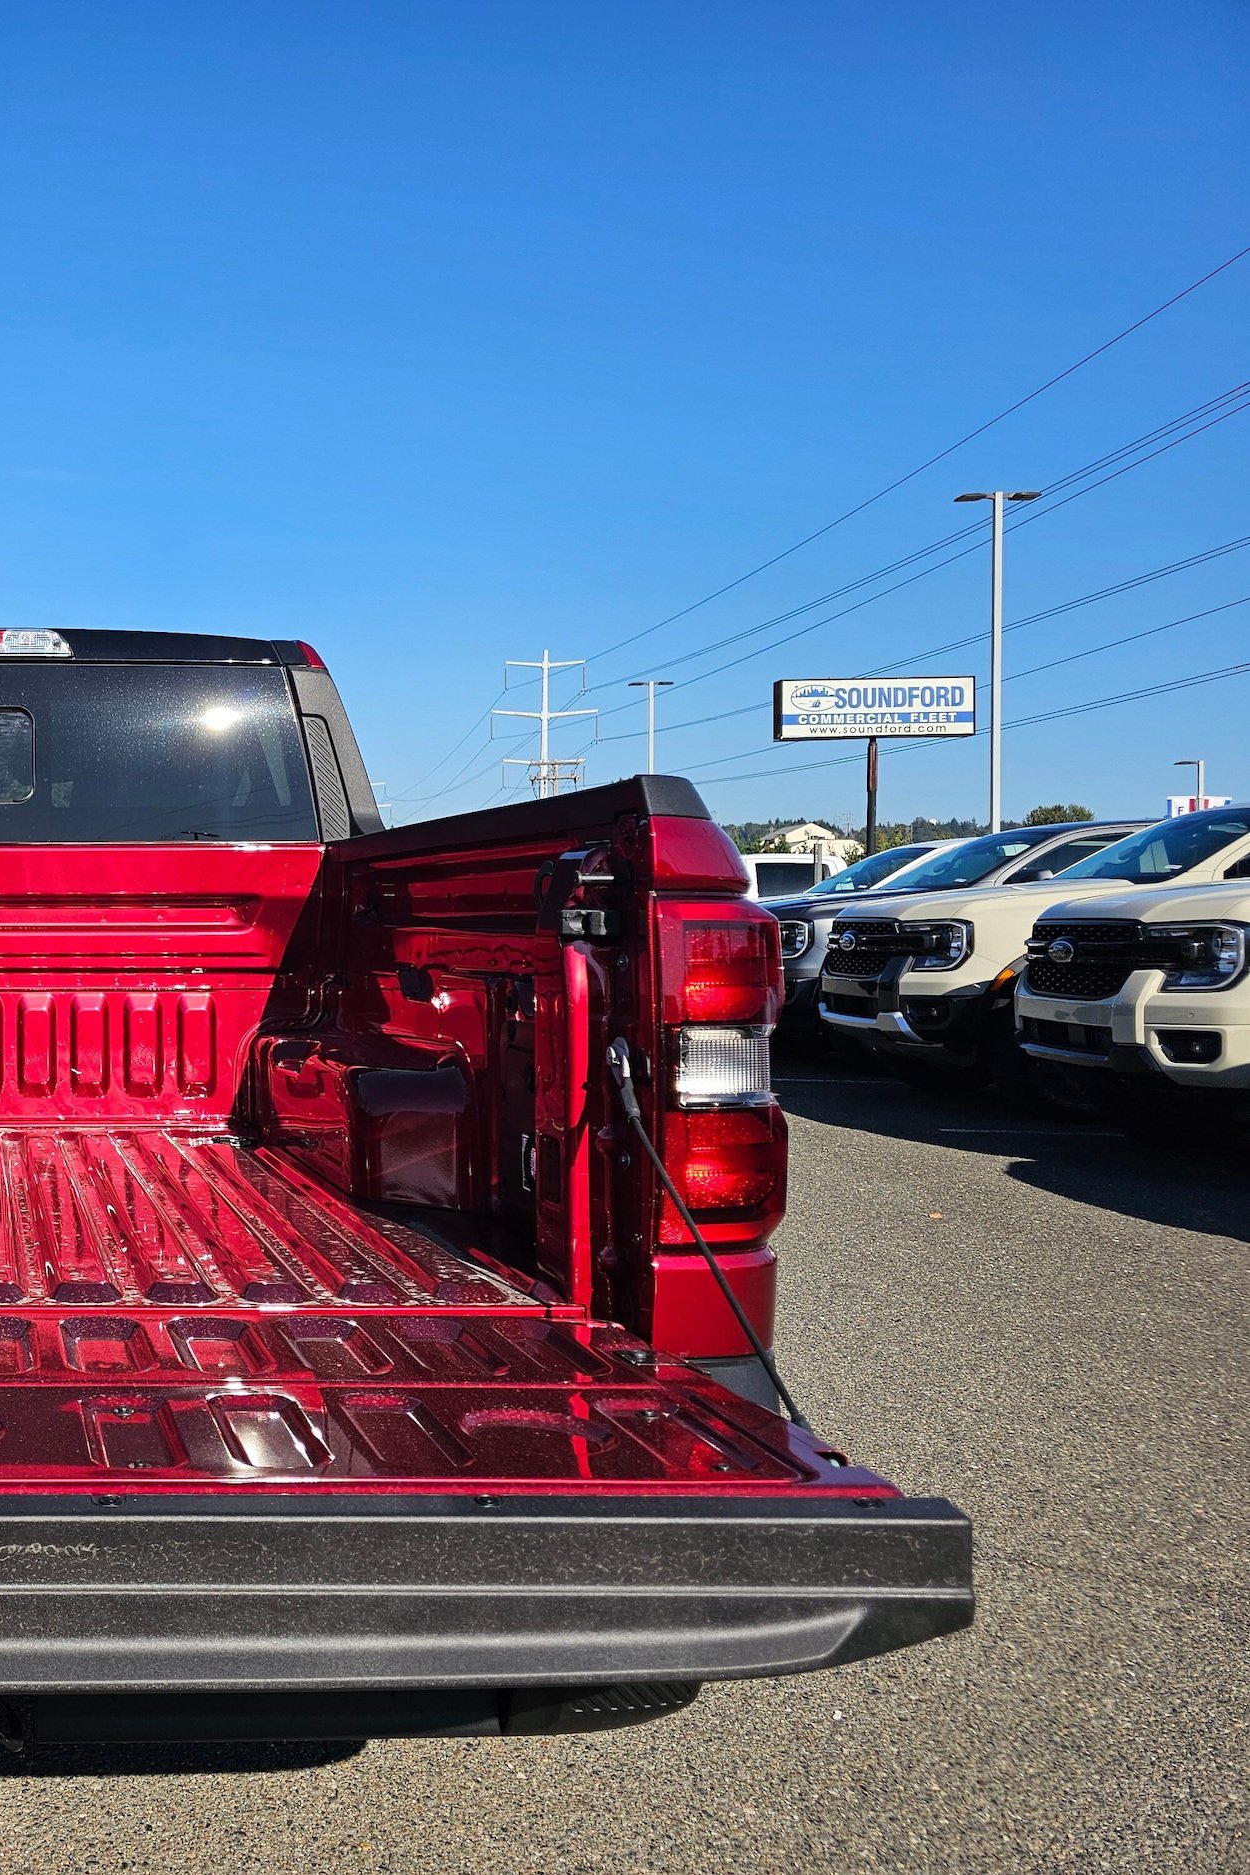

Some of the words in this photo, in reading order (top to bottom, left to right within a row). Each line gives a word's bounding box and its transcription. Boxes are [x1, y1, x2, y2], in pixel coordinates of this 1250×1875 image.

[834, 685, 965, 709] SOUNDFORD
[798, 713, 902, 725] COMMERCIAL
[910, 712, 957, 723] FLEET
[810, 724, 947, 734] www.soundford.com
